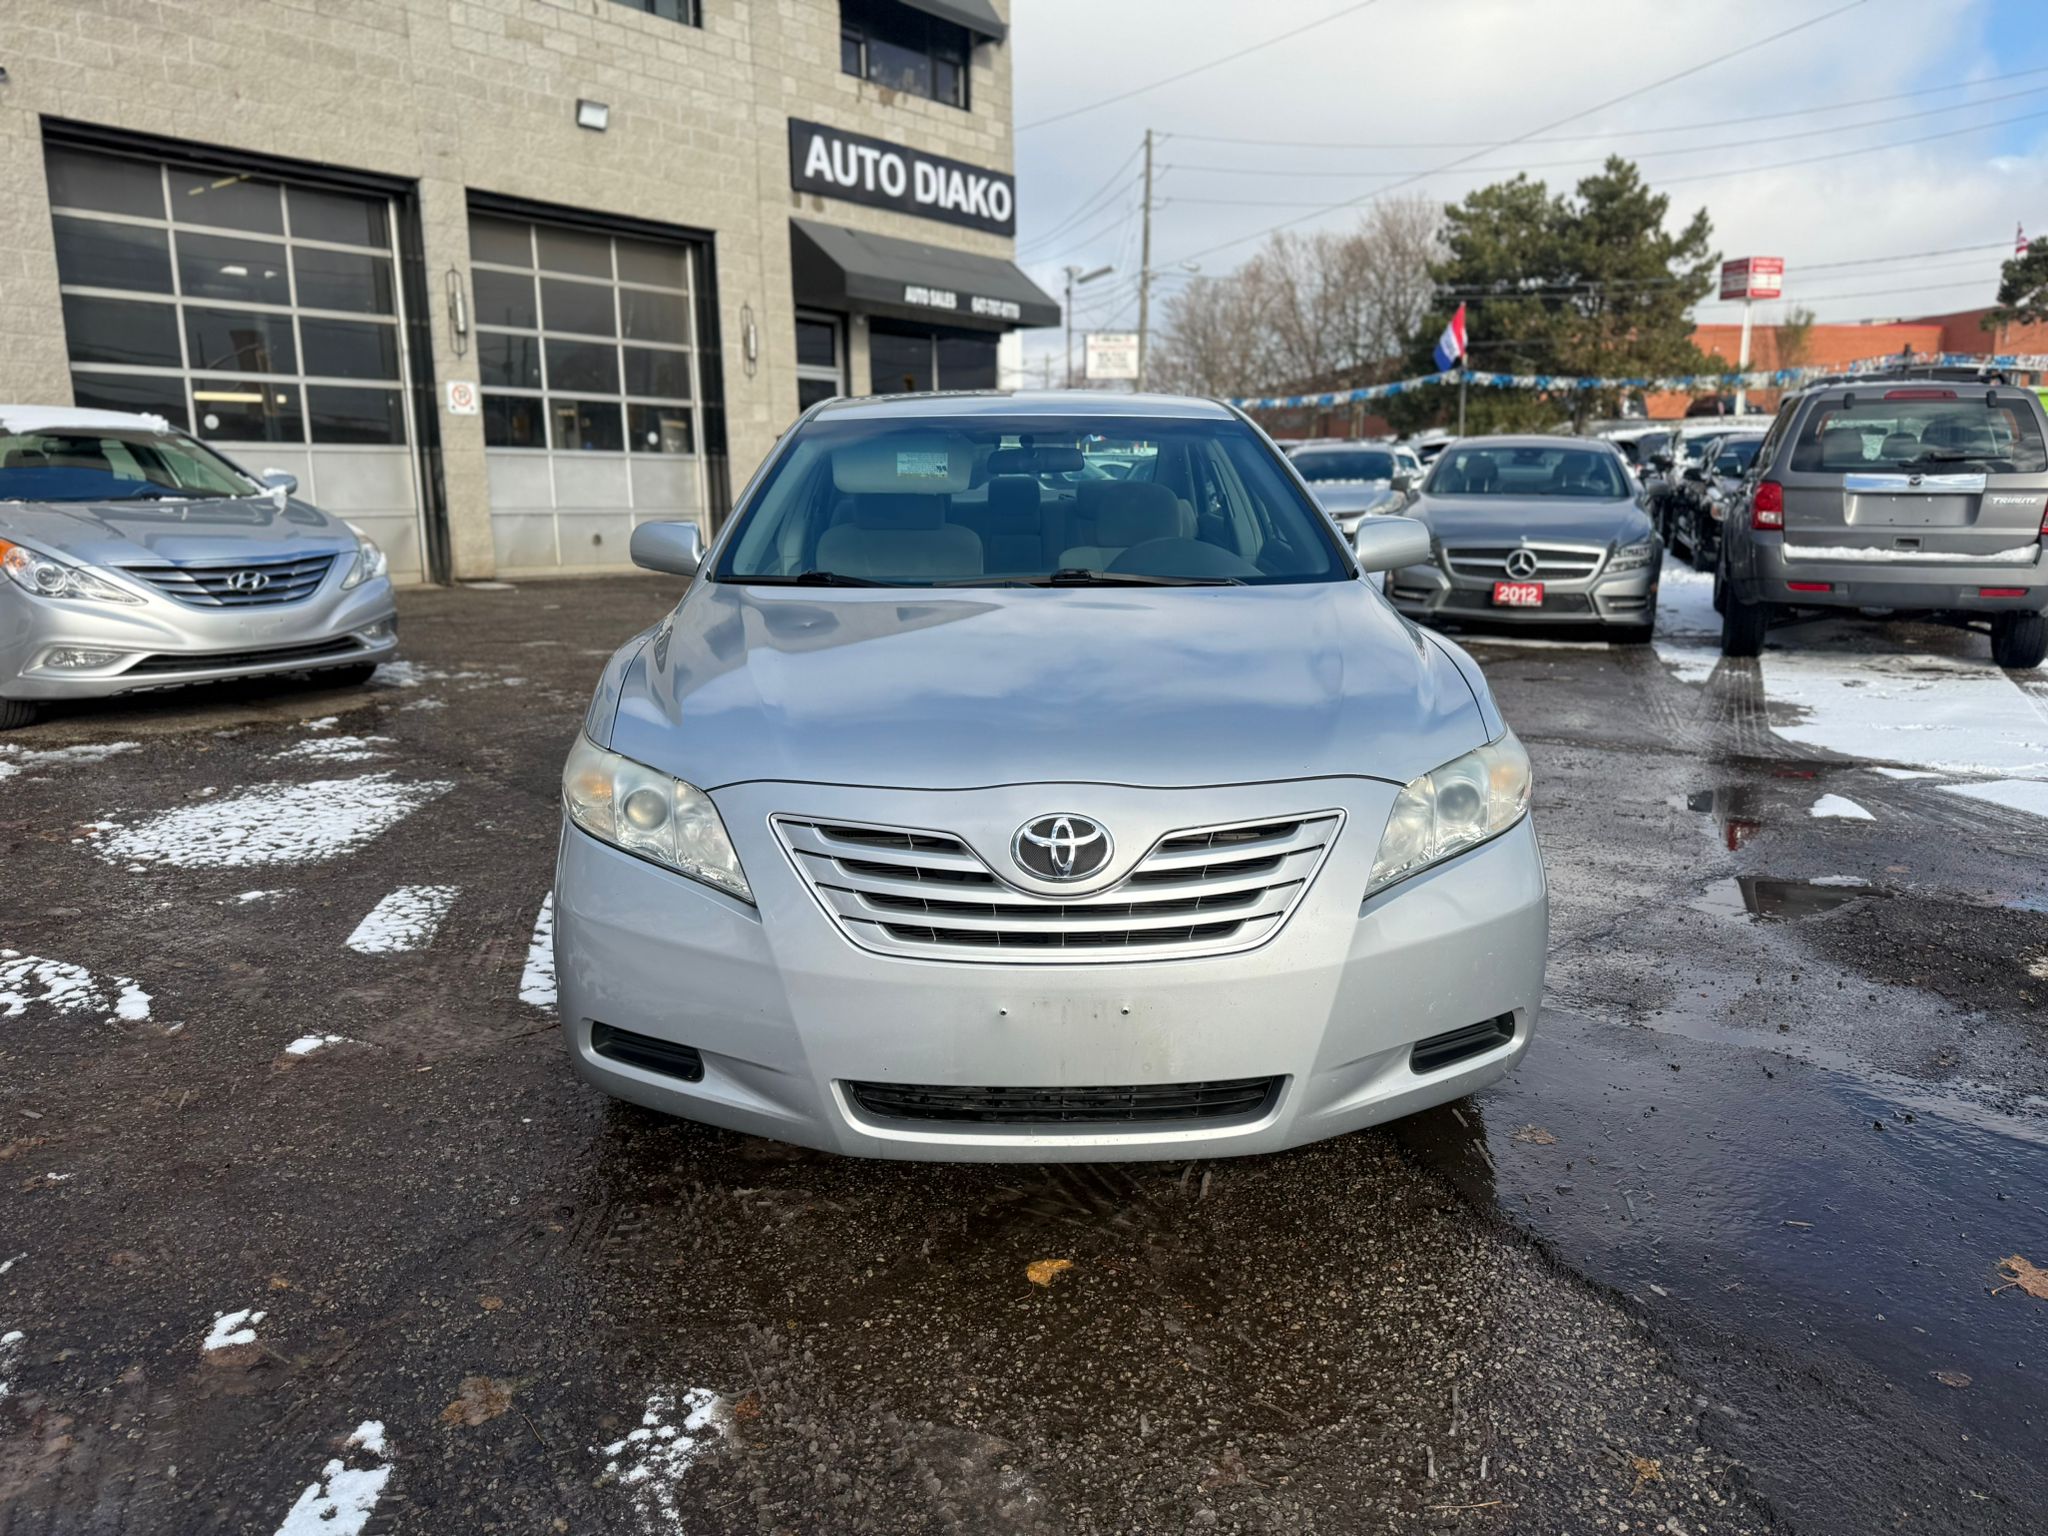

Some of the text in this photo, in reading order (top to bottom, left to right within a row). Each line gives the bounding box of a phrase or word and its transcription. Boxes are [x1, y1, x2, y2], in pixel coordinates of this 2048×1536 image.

[804, 134, 1012, 222] AUTO DIAKO
[904, 285, 929, 305] AUTO
[930, 288, 957, 310] SALES
[1498, 585, 1538, 602] 2012
